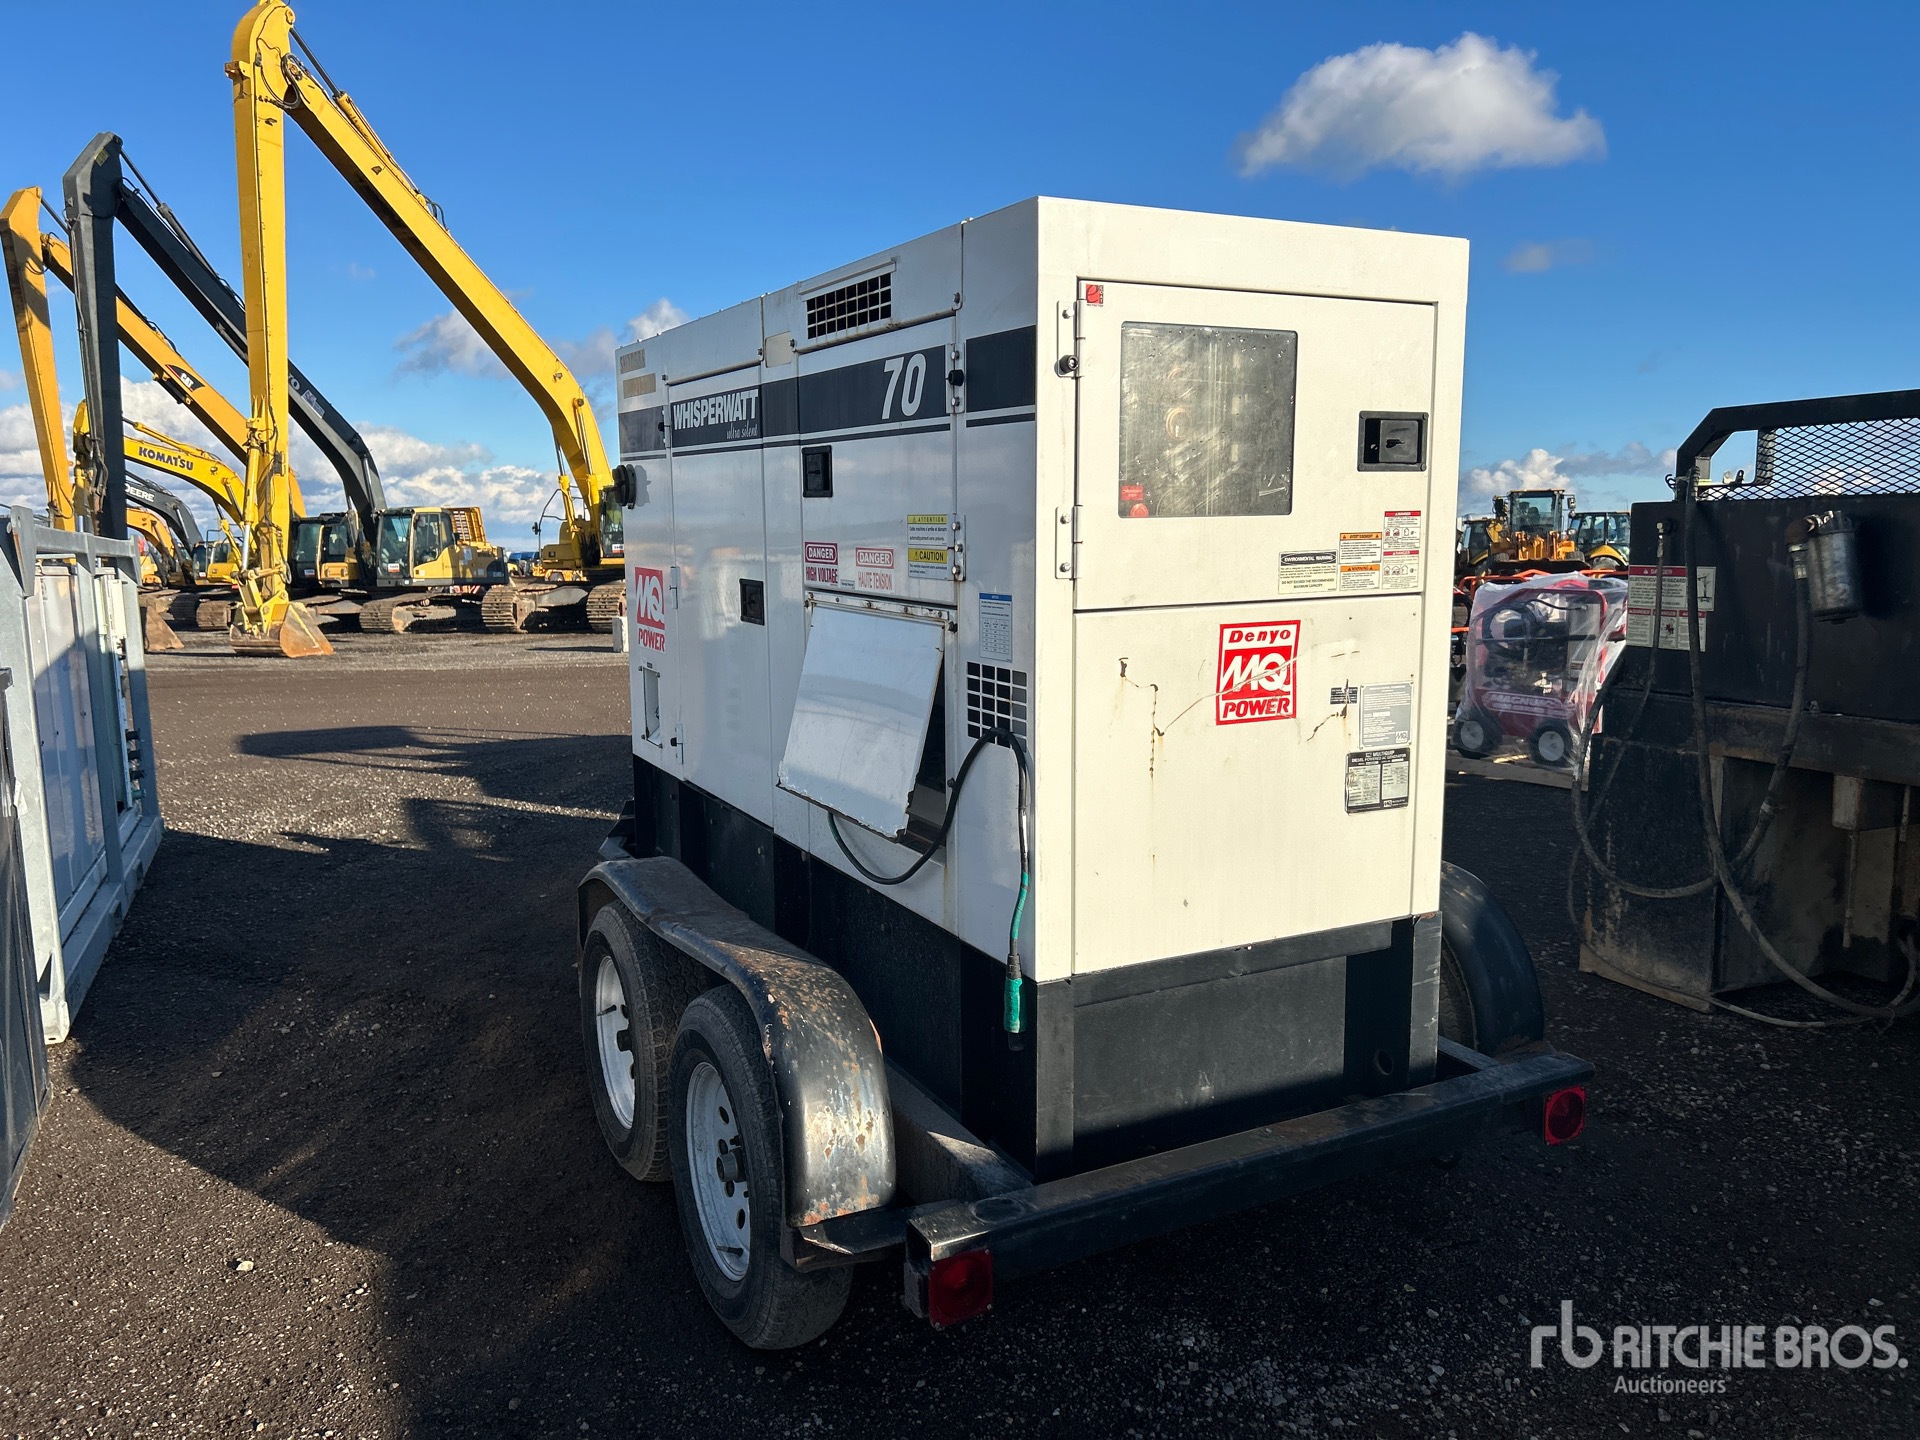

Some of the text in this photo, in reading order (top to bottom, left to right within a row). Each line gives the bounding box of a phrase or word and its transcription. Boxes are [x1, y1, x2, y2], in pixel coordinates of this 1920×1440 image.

[180, 372, 194, 388] CAT
[881, 352, 927, 420] 70
[673, 389, 759, 431] WHISPERWATT
[138, 446, 194, 471] KOMATSU
[808, 547, 834, 559] DANGER
[859, 552, 890, 565] DANGER
[919, 551, 944, 561] CAUTION
[805, 566, 838, 583] HIGH VOLTAGE
[857, 571, 873, 589] HAUTE
[872, 571, 893, 591] TENSION
[635, 574, 665, 625] MQ
[638, 627, 665, 653] POWER
[1228, 628, 1291, 644] Denyo
[1220, 652, 1291, 693] MQ
[1222, 697, 1291, 719] POWER
